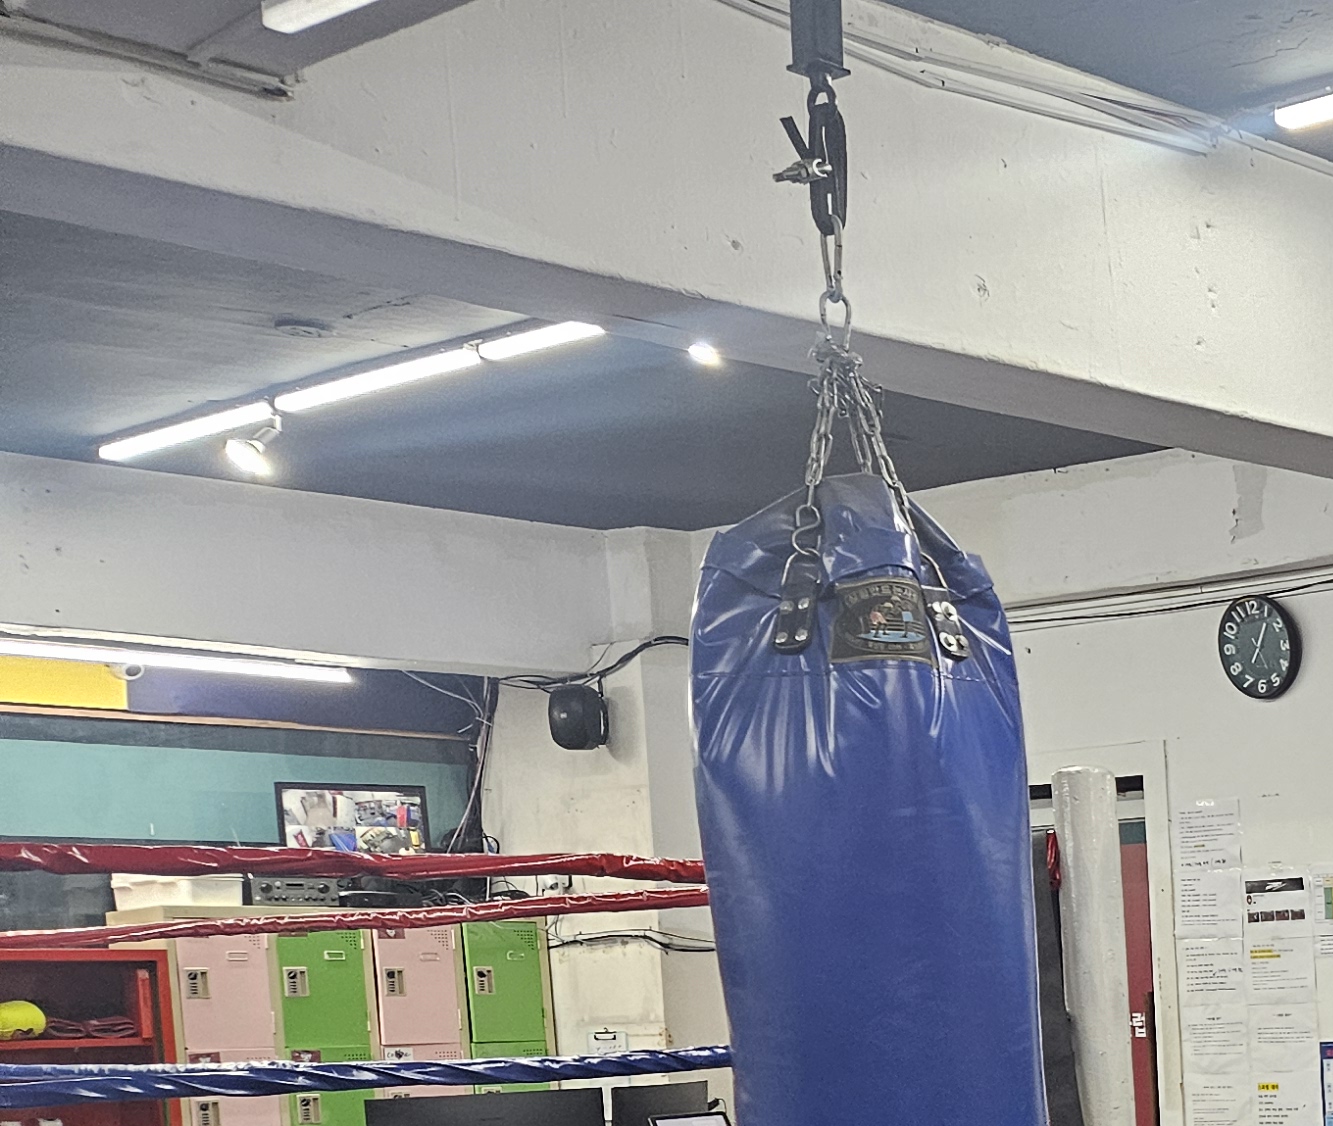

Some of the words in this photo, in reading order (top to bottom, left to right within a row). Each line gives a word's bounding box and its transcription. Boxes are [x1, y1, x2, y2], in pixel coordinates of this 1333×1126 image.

[1231, 606, 1245, 622] 11
[1245, 601, 1260, 614] 12
[1223, 622, 1238, 640] 10
[1272, 618, 1283, 632] 2
[1224, 644, 1235, 655] 9
[1280, 640, 1290, 651] 3
[1230, 662, 1243, 675] 8
[1279, 658, 1289, 671] 4
[1243, 675, 1255, 688] 7
[1270, 673, 1280, 686] 5
[1258, 680, 1266, 693] 6
